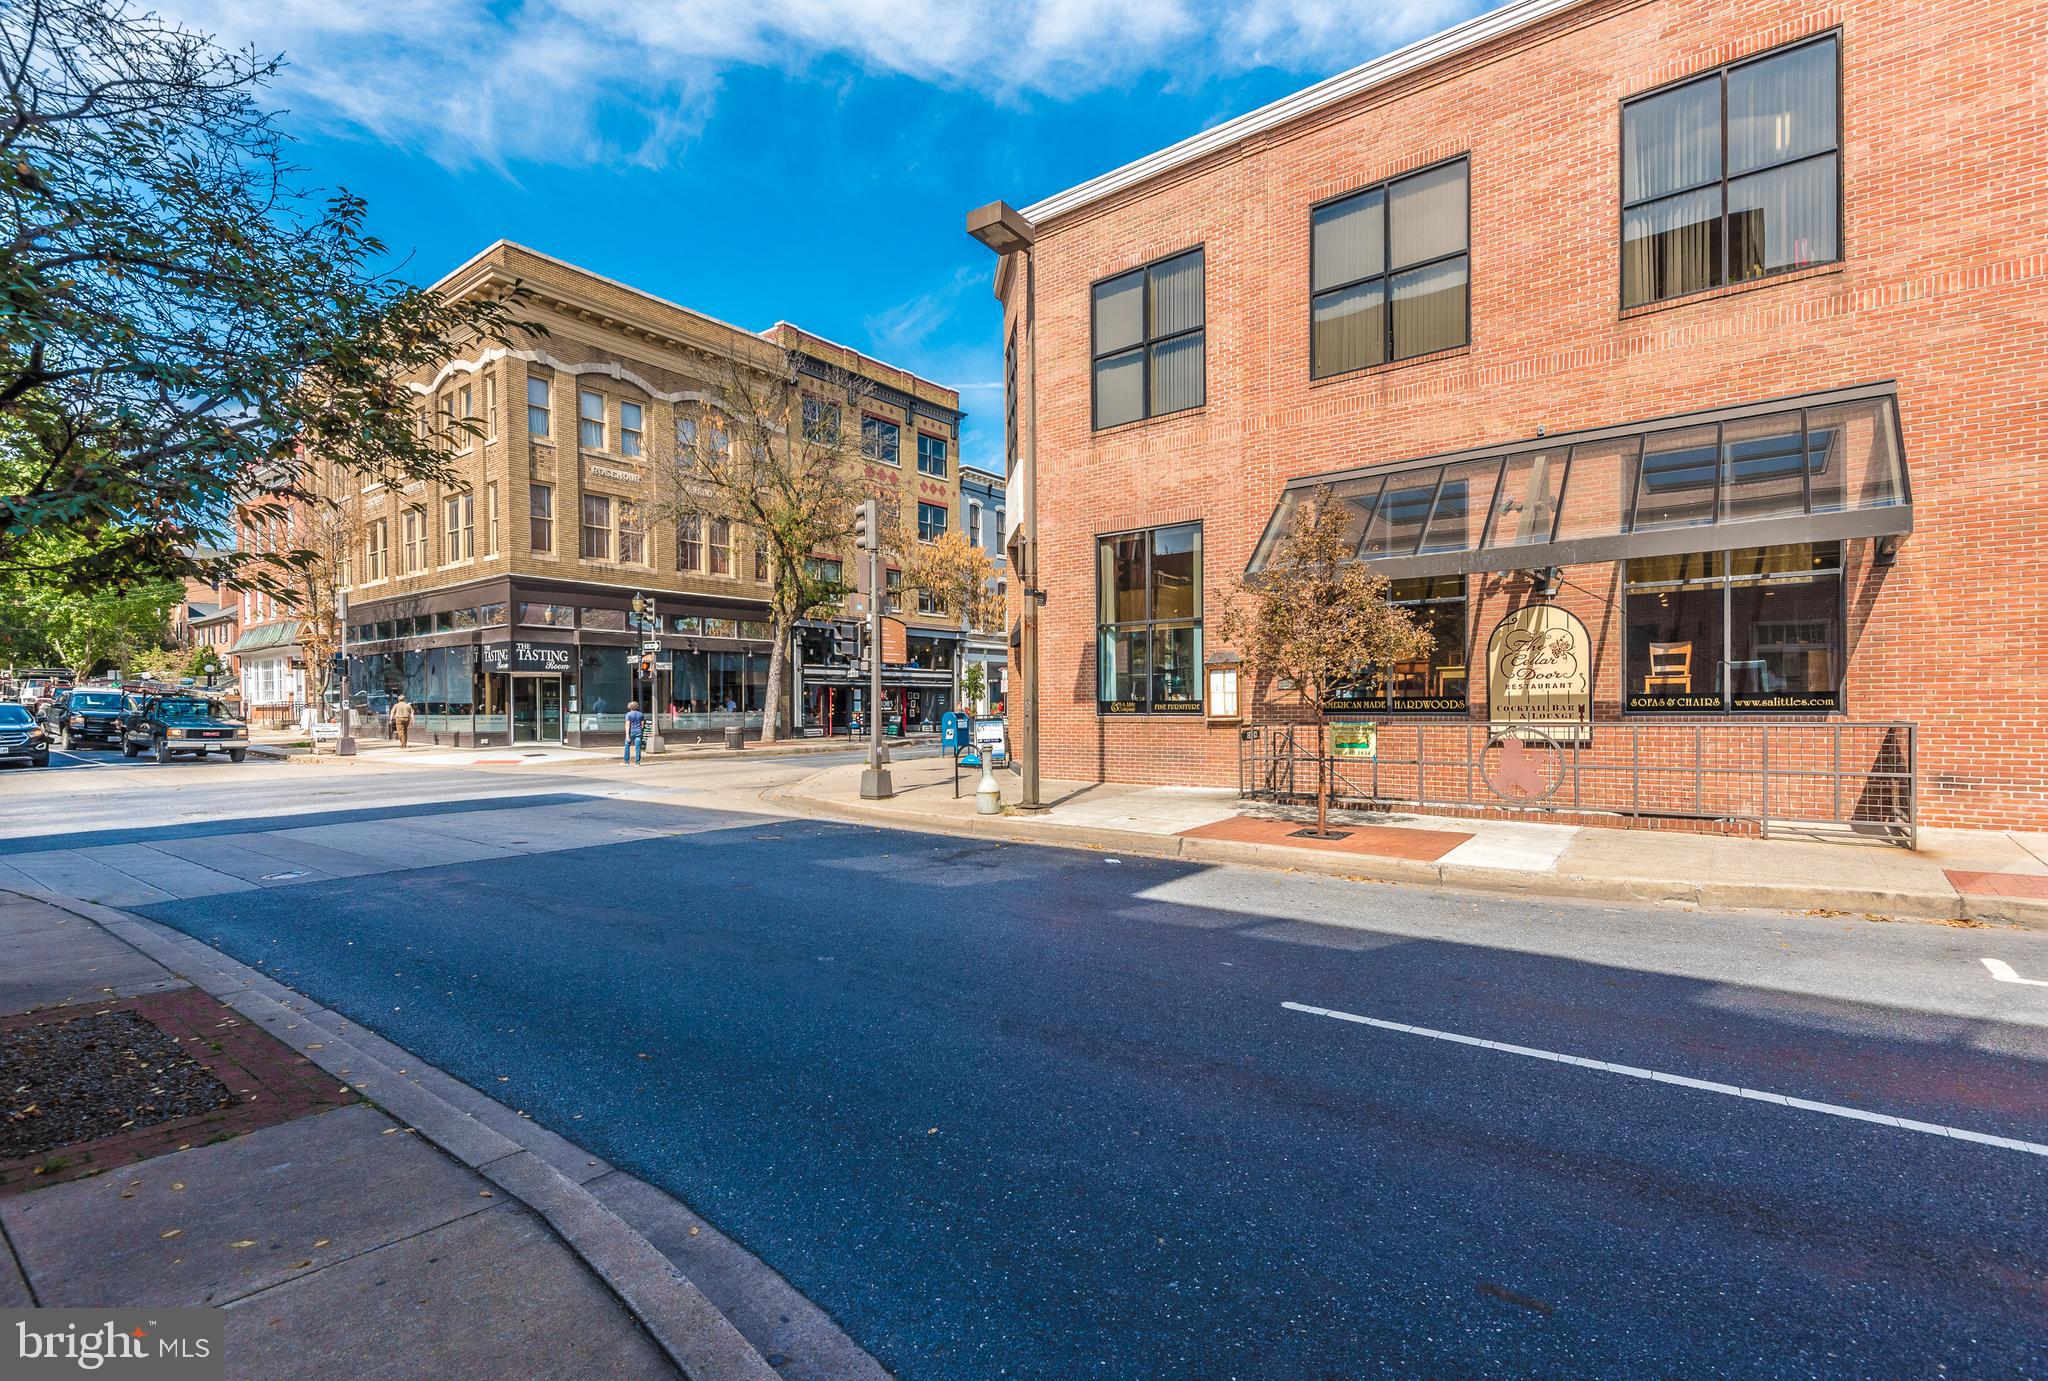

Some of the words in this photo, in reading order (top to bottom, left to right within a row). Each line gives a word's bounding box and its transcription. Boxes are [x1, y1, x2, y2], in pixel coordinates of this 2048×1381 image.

[516, 643, 531, 651] THE
[1513, 635, 1546, 652] The
[484, 649, 509, 663] TASTING
[518, 649, 569, 662] TASTING
[1511, 653, 1557, 667] Cellar
[545, 661, 570, 670] Room
[1516, 667, 1562, 680] Door
[1504, 682, 1573, 690] RESTAURANT
[1363, 700, 1386, 709] MADE
[1394, 699, 1466, 710] HARDWOODS
[1630, 698, 1665, 707] SOFAS
[1666, 698, 1675, 706] &
[1676, 697, 1721, 707] CHAIRS
[1734, 697, 1835, 707] www.salittles.com
[1519, 712, 1527, 720] &
[1532, 712, 1575, 720] LOUNGE
